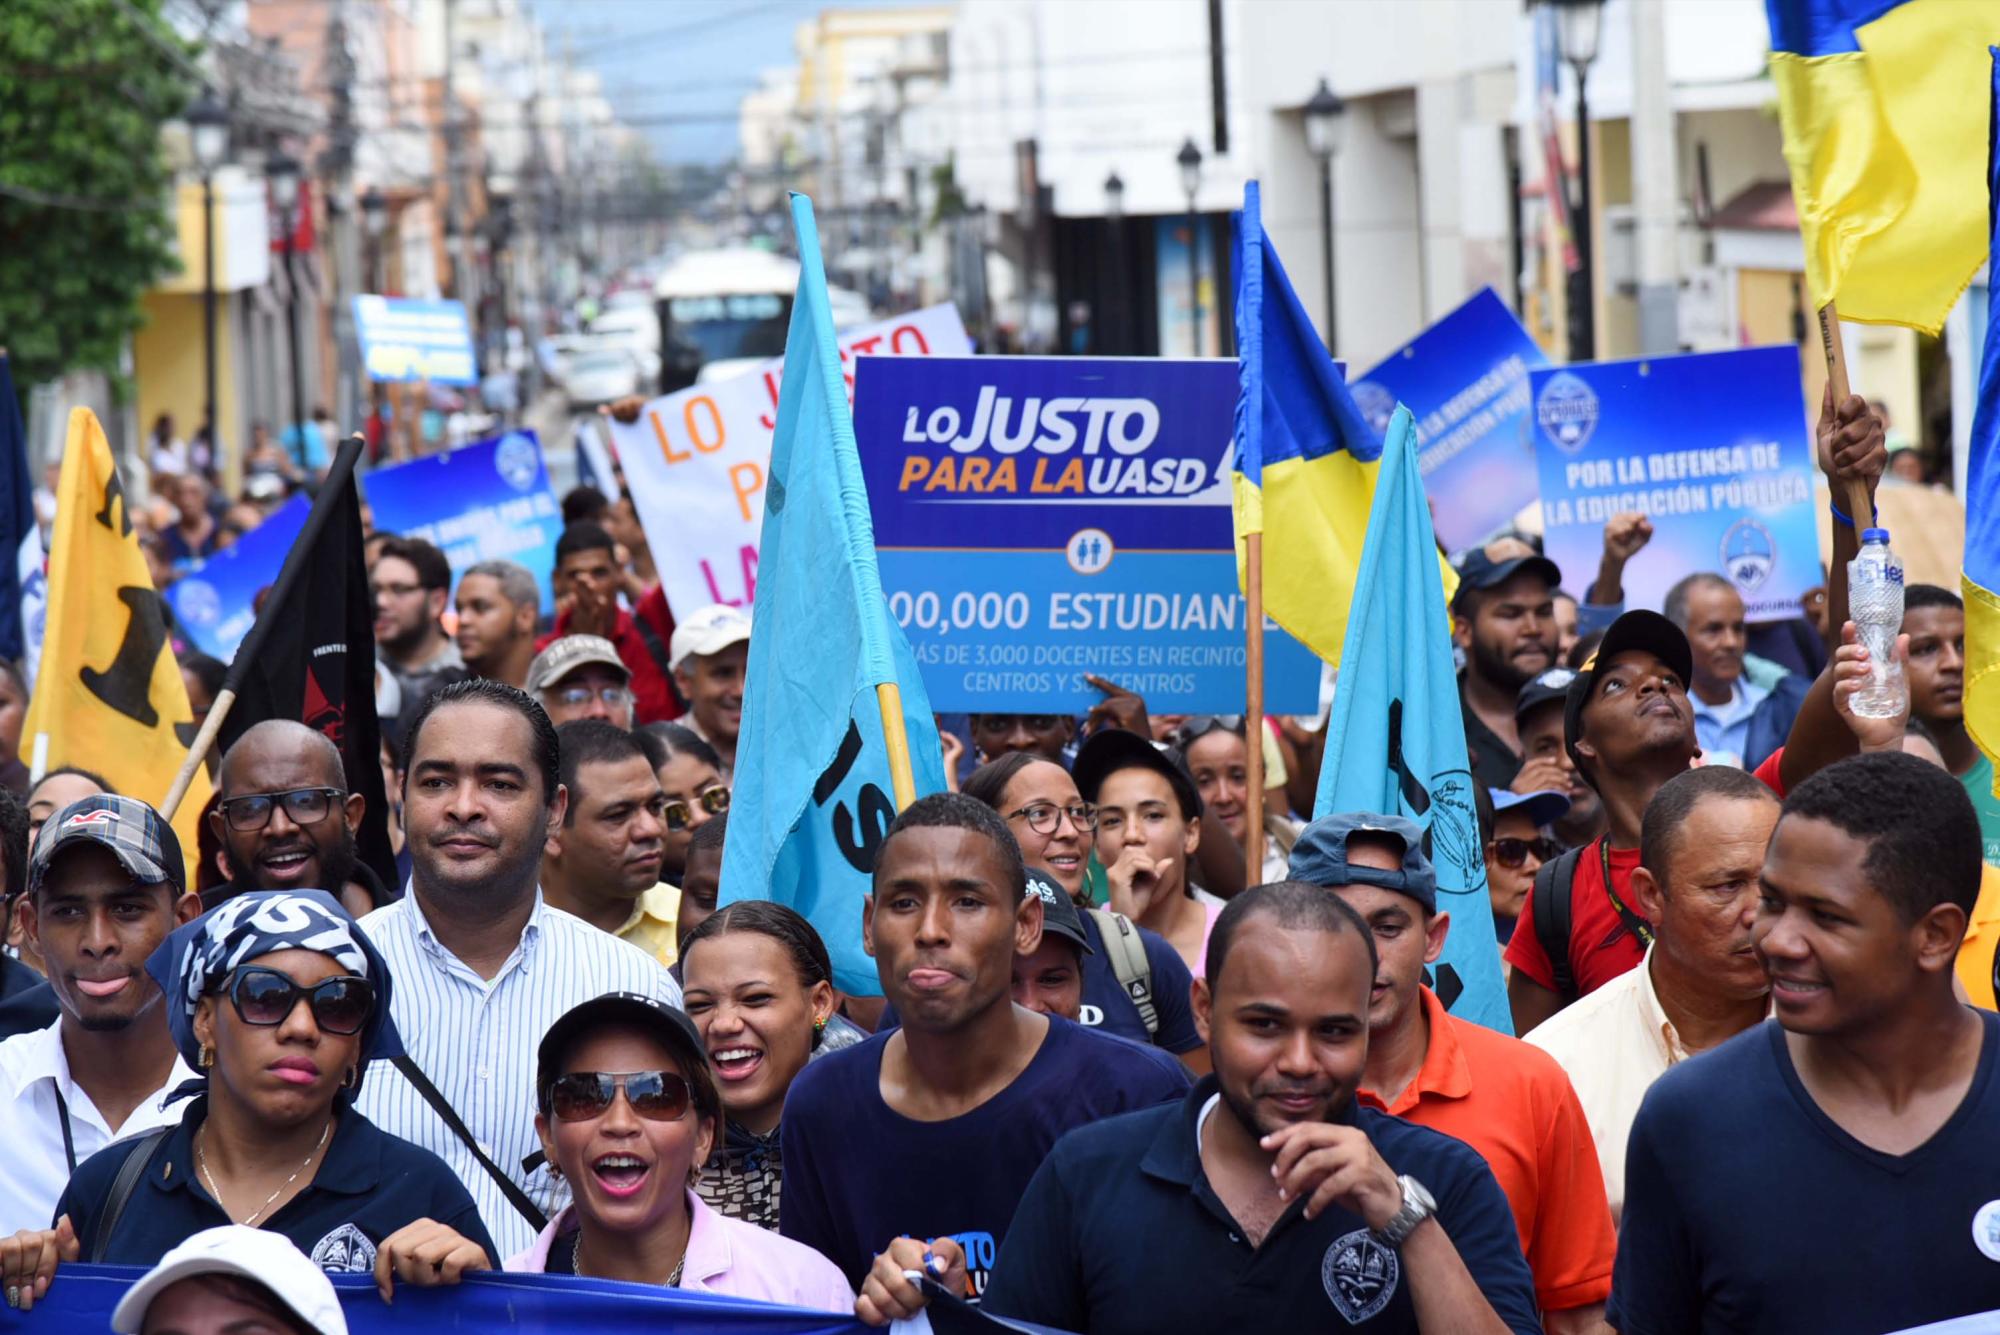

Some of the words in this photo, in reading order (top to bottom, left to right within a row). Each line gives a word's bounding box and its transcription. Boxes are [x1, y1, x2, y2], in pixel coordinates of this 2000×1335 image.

[649, 395, 726, 465] LO
[902, 406, 960, 443] LO
[949, 385, 1161, 455] JUSTO
[898, 456, 1018, 492] PARA
[1030, 457, 1085, 493] LA
[1087, 457, 1207, 494] UASD
[1565, 459, 1614, 490] POR
[1616, 455, 1647, 485] LA
[1648, 446, 1747, 482] DEFENSA
[1750, 441, 1780, 471] DE
[1545, 499, 1573, 526] LA
[1576, 482, 1708, 524] EDUCACIÓN
[1710, 473, 1809, 511] PÚBLICA
[882, 591, 1030, 635] 00,000
[944, 644, 970, 665] DE
[975, 645, 1029, 667] 3,000
[1034, 645, 1133, 667] DOCENTES
[1137, 648, 1163, 667] EN
[1168, 647, 1247, 668] RECINTO
[963, 671, 1051, 693] CENTROS
[1055, 673, 1068, 693] Y
